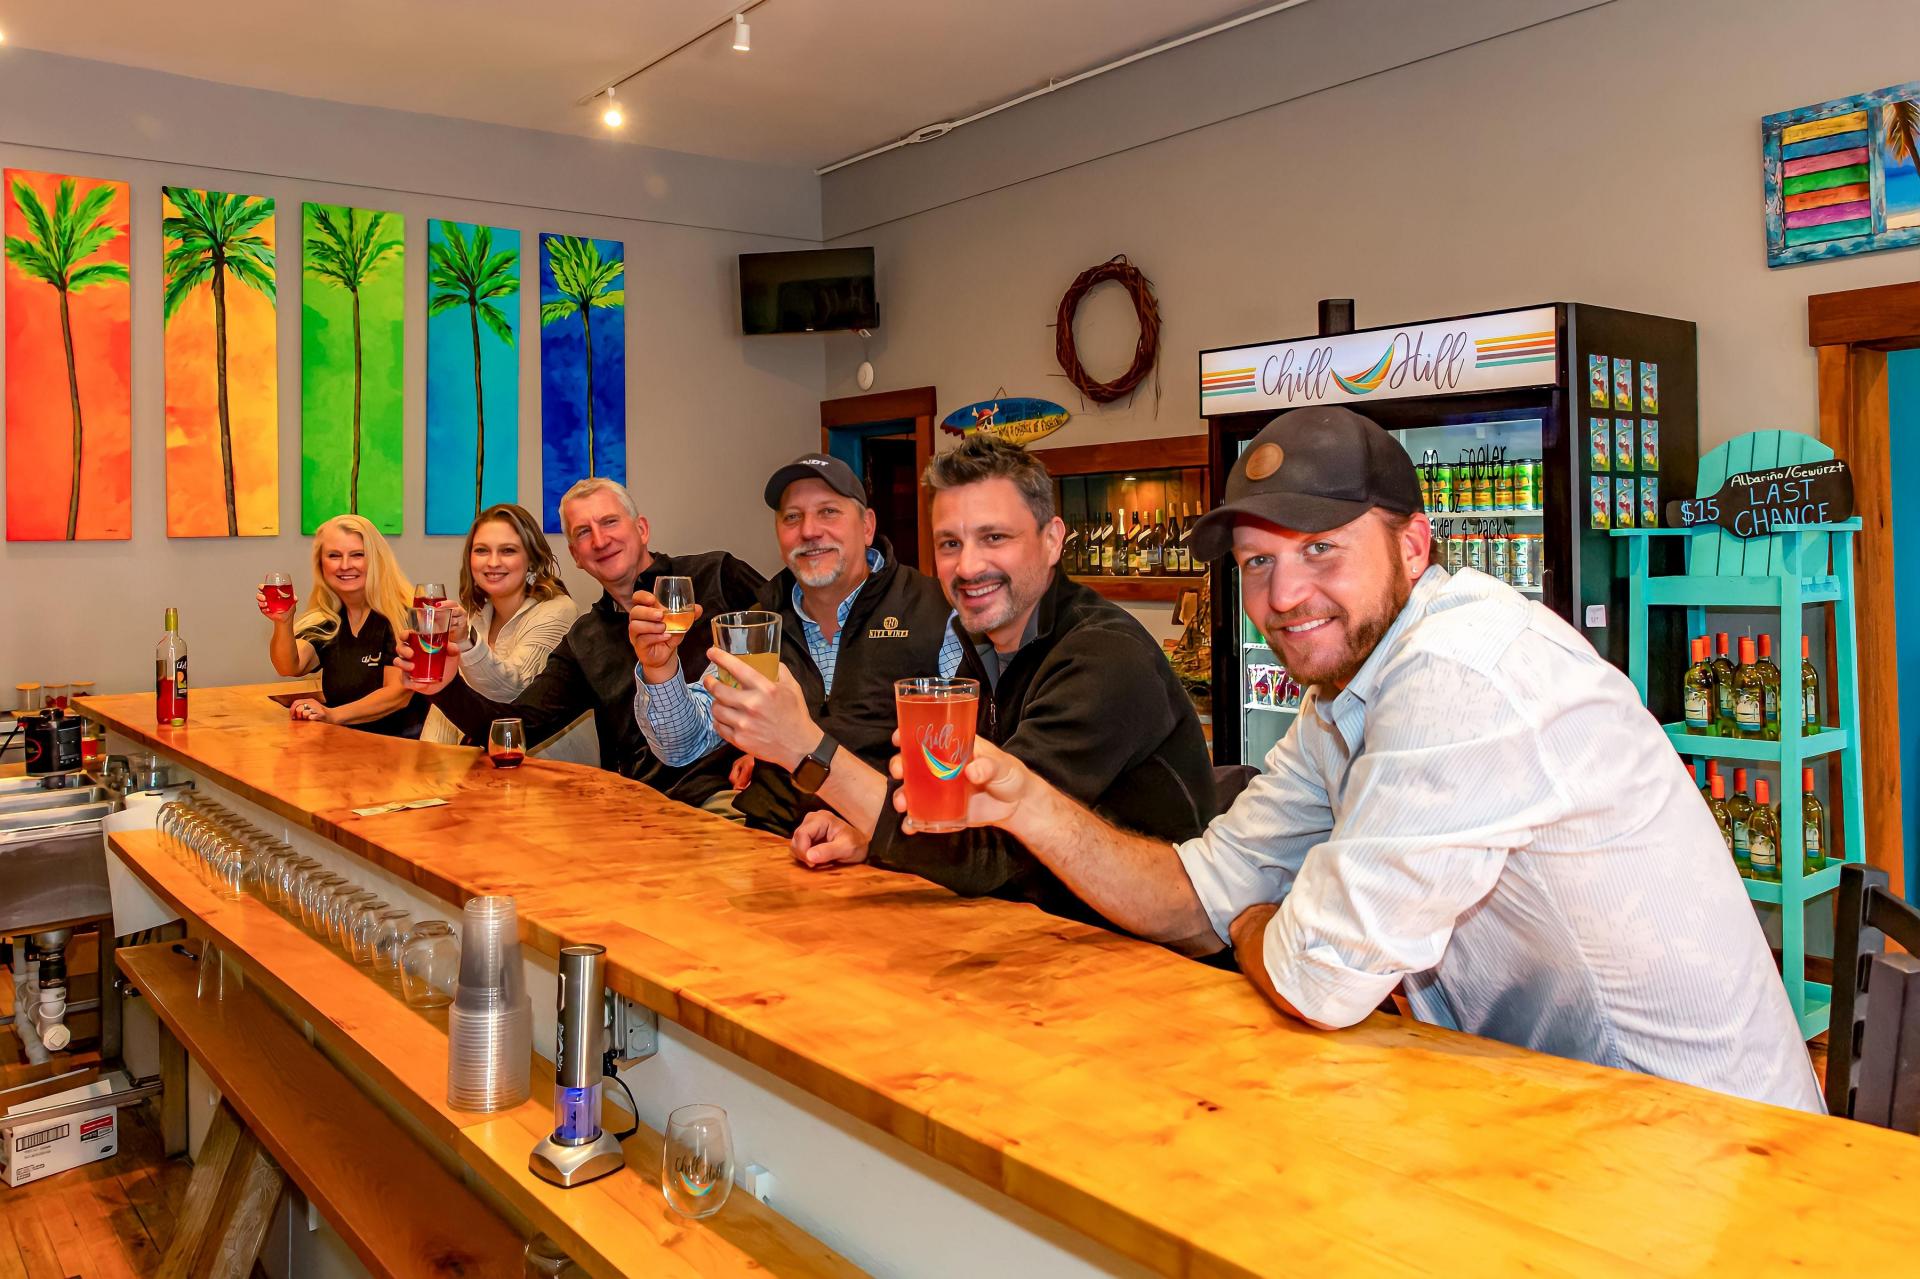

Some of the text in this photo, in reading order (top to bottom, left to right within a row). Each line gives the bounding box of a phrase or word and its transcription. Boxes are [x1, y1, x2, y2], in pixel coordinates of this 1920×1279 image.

[1262, 331, 1467, 402] Chill Hill
[1750, 479, 1815, 505] LAST
[1680, 499, 1720, 526] $15
[1735, 502, 1833, 537] CHANCE
